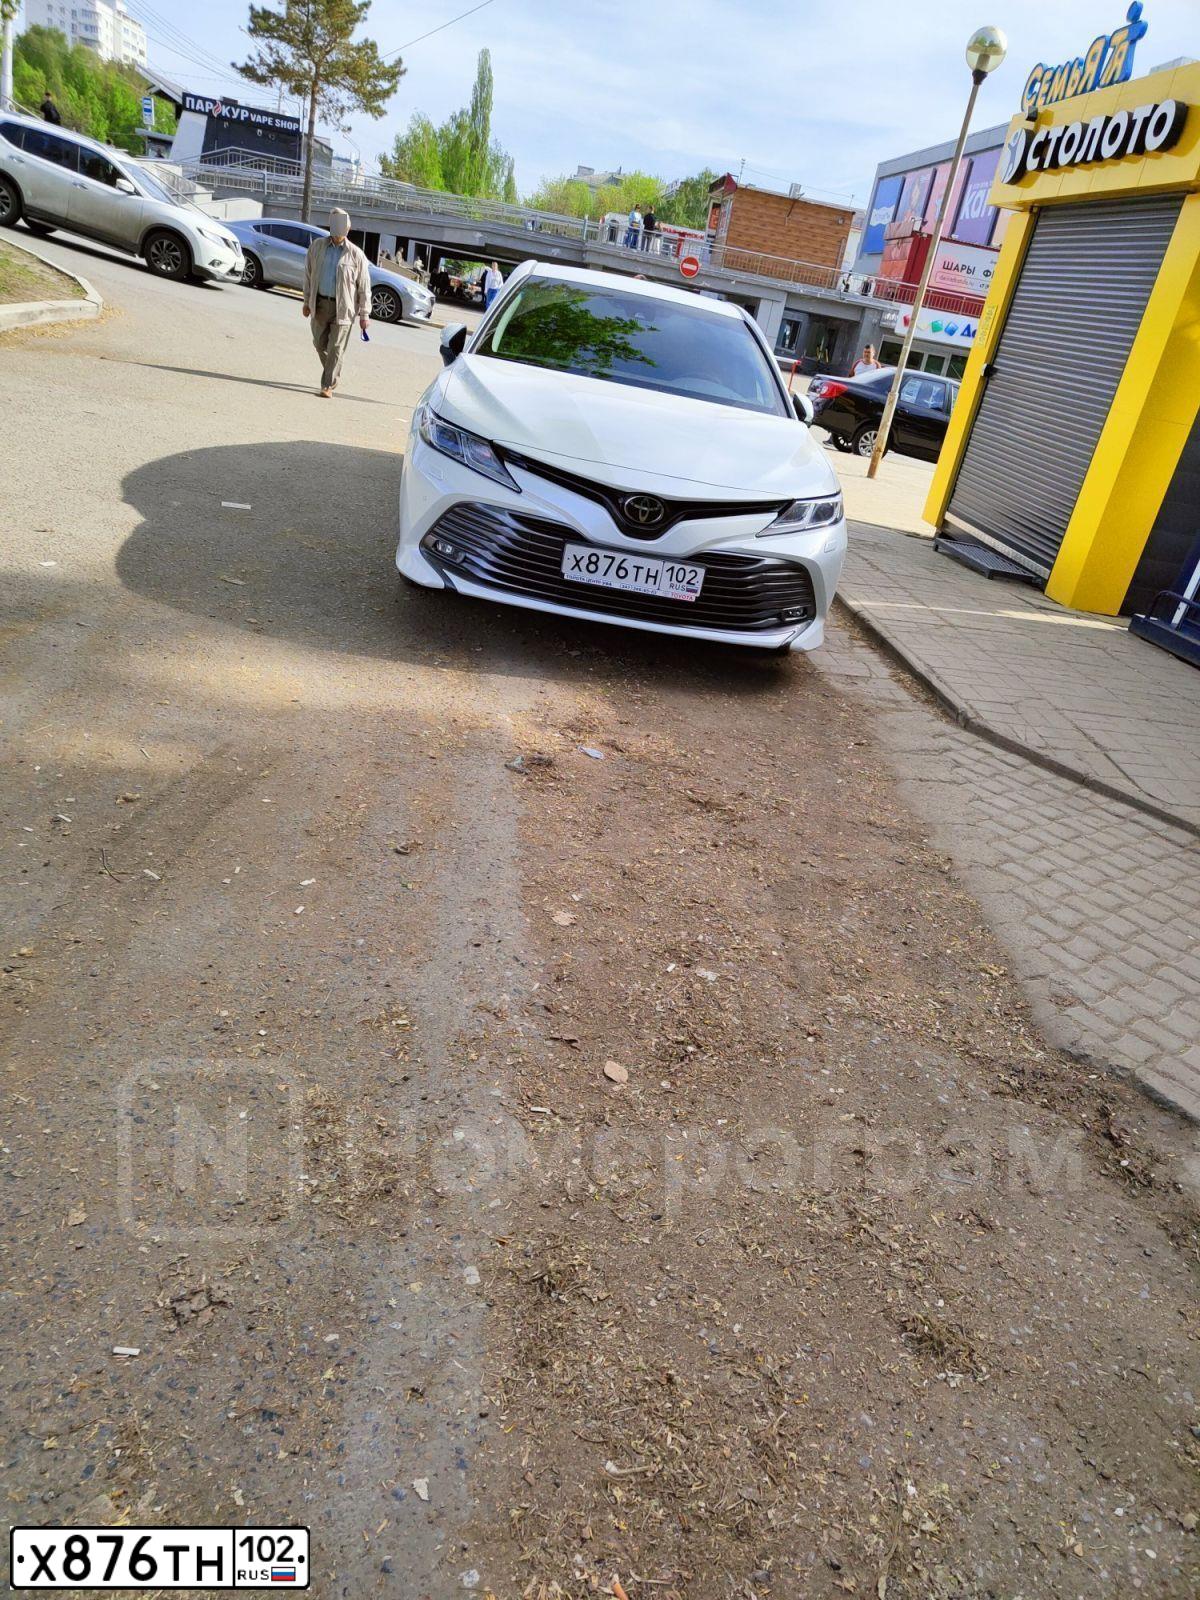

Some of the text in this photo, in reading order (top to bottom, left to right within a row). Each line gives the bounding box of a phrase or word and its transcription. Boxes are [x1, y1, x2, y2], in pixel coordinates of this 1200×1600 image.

[250, 112, 299, 131] VAPE SHOP
[1026, 99, 1176, 171] СТОЛОТО
[942, 260, 976, 275] ШАРЫ
[665, 565, 698, 586] 102
[669, 582, 686, 592] RUS
